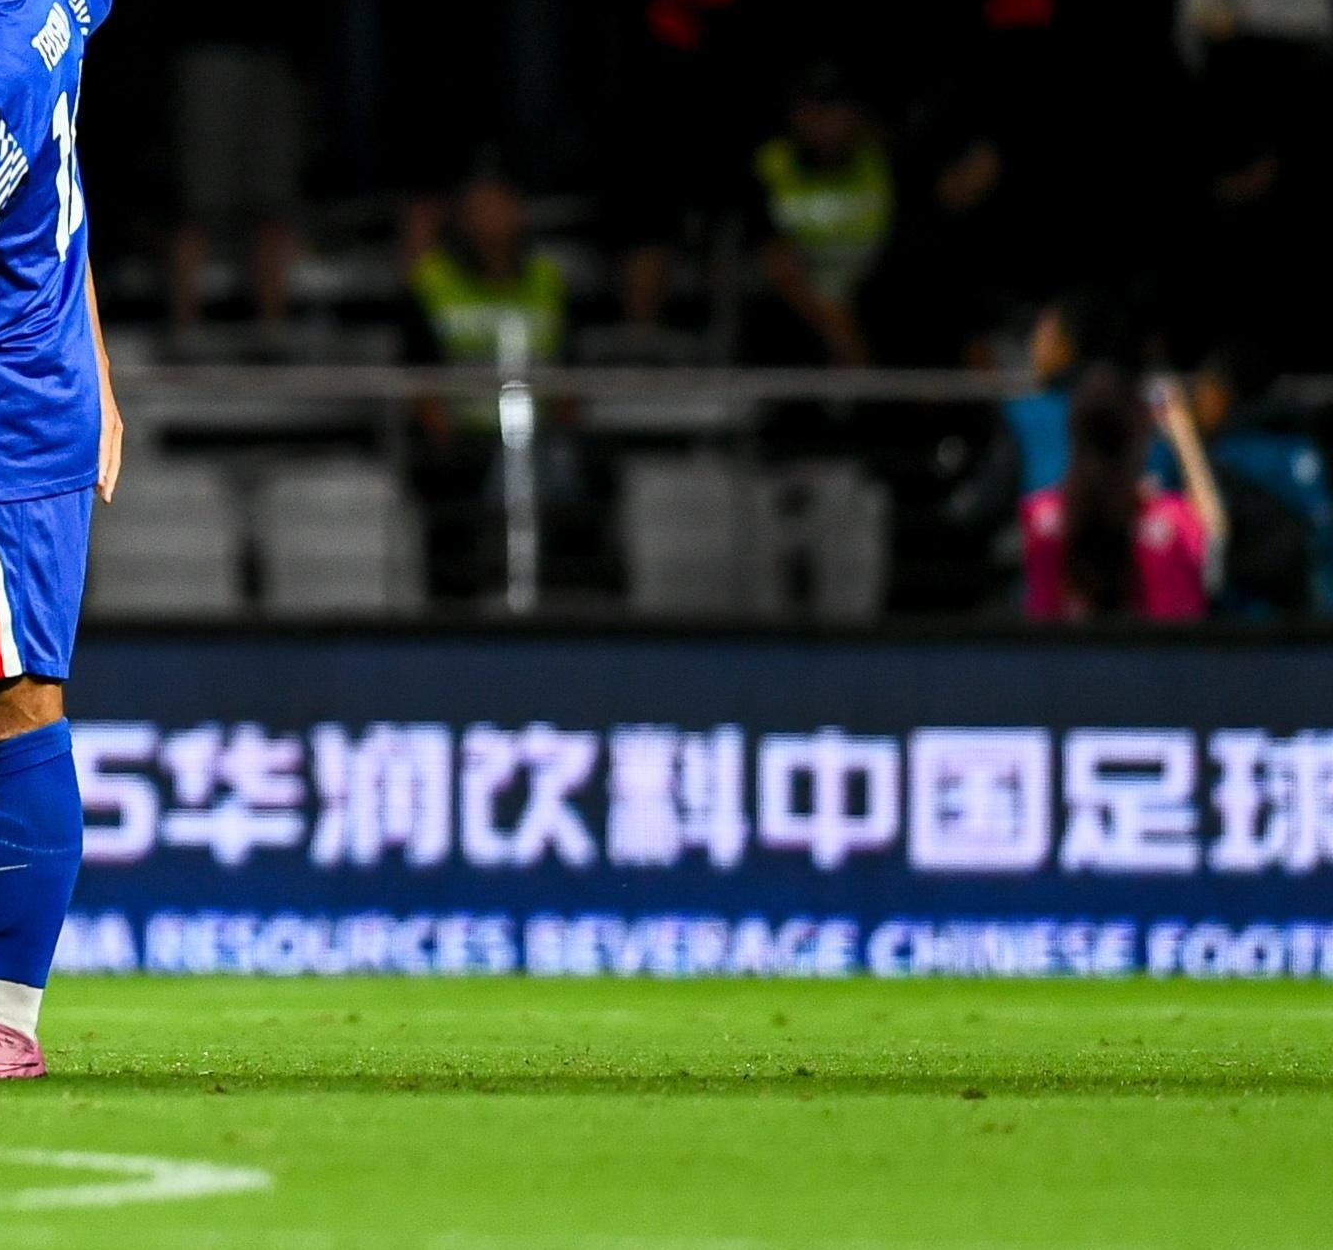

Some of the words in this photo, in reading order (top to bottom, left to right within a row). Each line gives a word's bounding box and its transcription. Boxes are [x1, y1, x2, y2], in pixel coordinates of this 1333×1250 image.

[144, 913, 517, 973] RESOURCES
[528, 915, 858, 975] BEVERAGE
[868, 920, 1134, 976] CHINESE
[1147, 922, 1333, 978] FOOT
